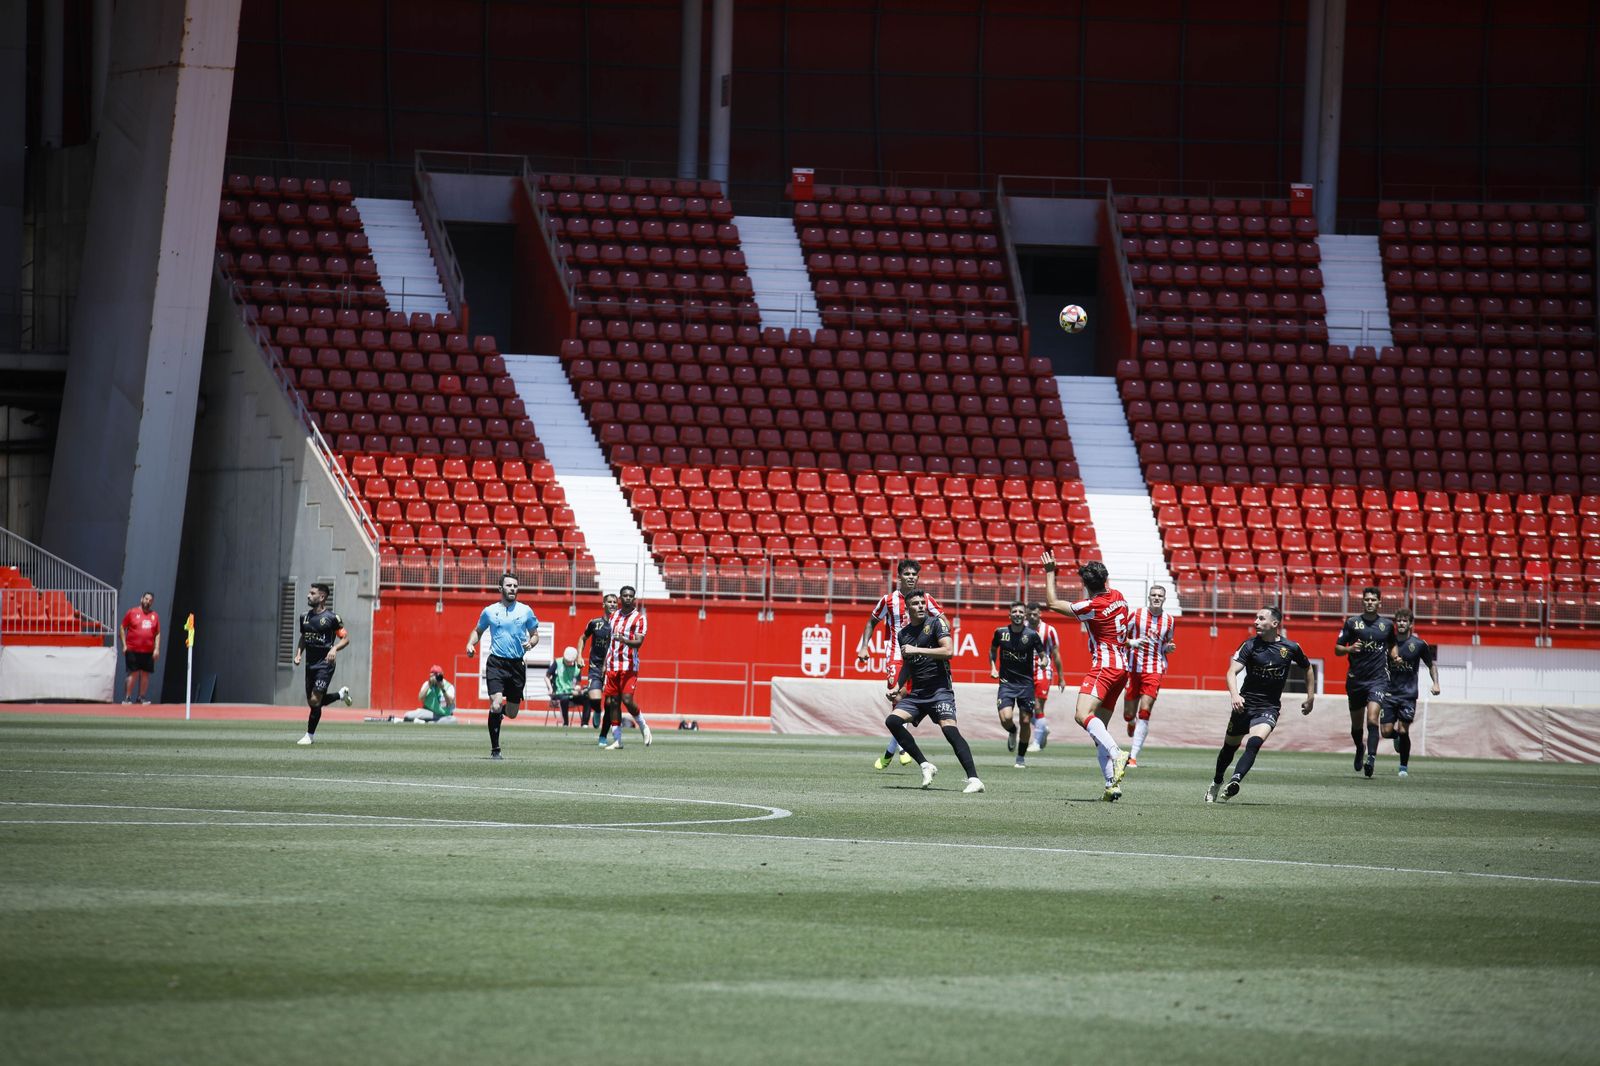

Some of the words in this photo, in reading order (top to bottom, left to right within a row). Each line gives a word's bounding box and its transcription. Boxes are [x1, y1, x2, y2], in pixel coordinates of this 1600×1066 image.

[594, 622, 604, 630] 17
[1114, 613, 1127, 643] 5
[1354, 621, 1365, 630] 16
[1001, 632, 1011, 642] 10
[856, 628, 979, 657] ALÍA
